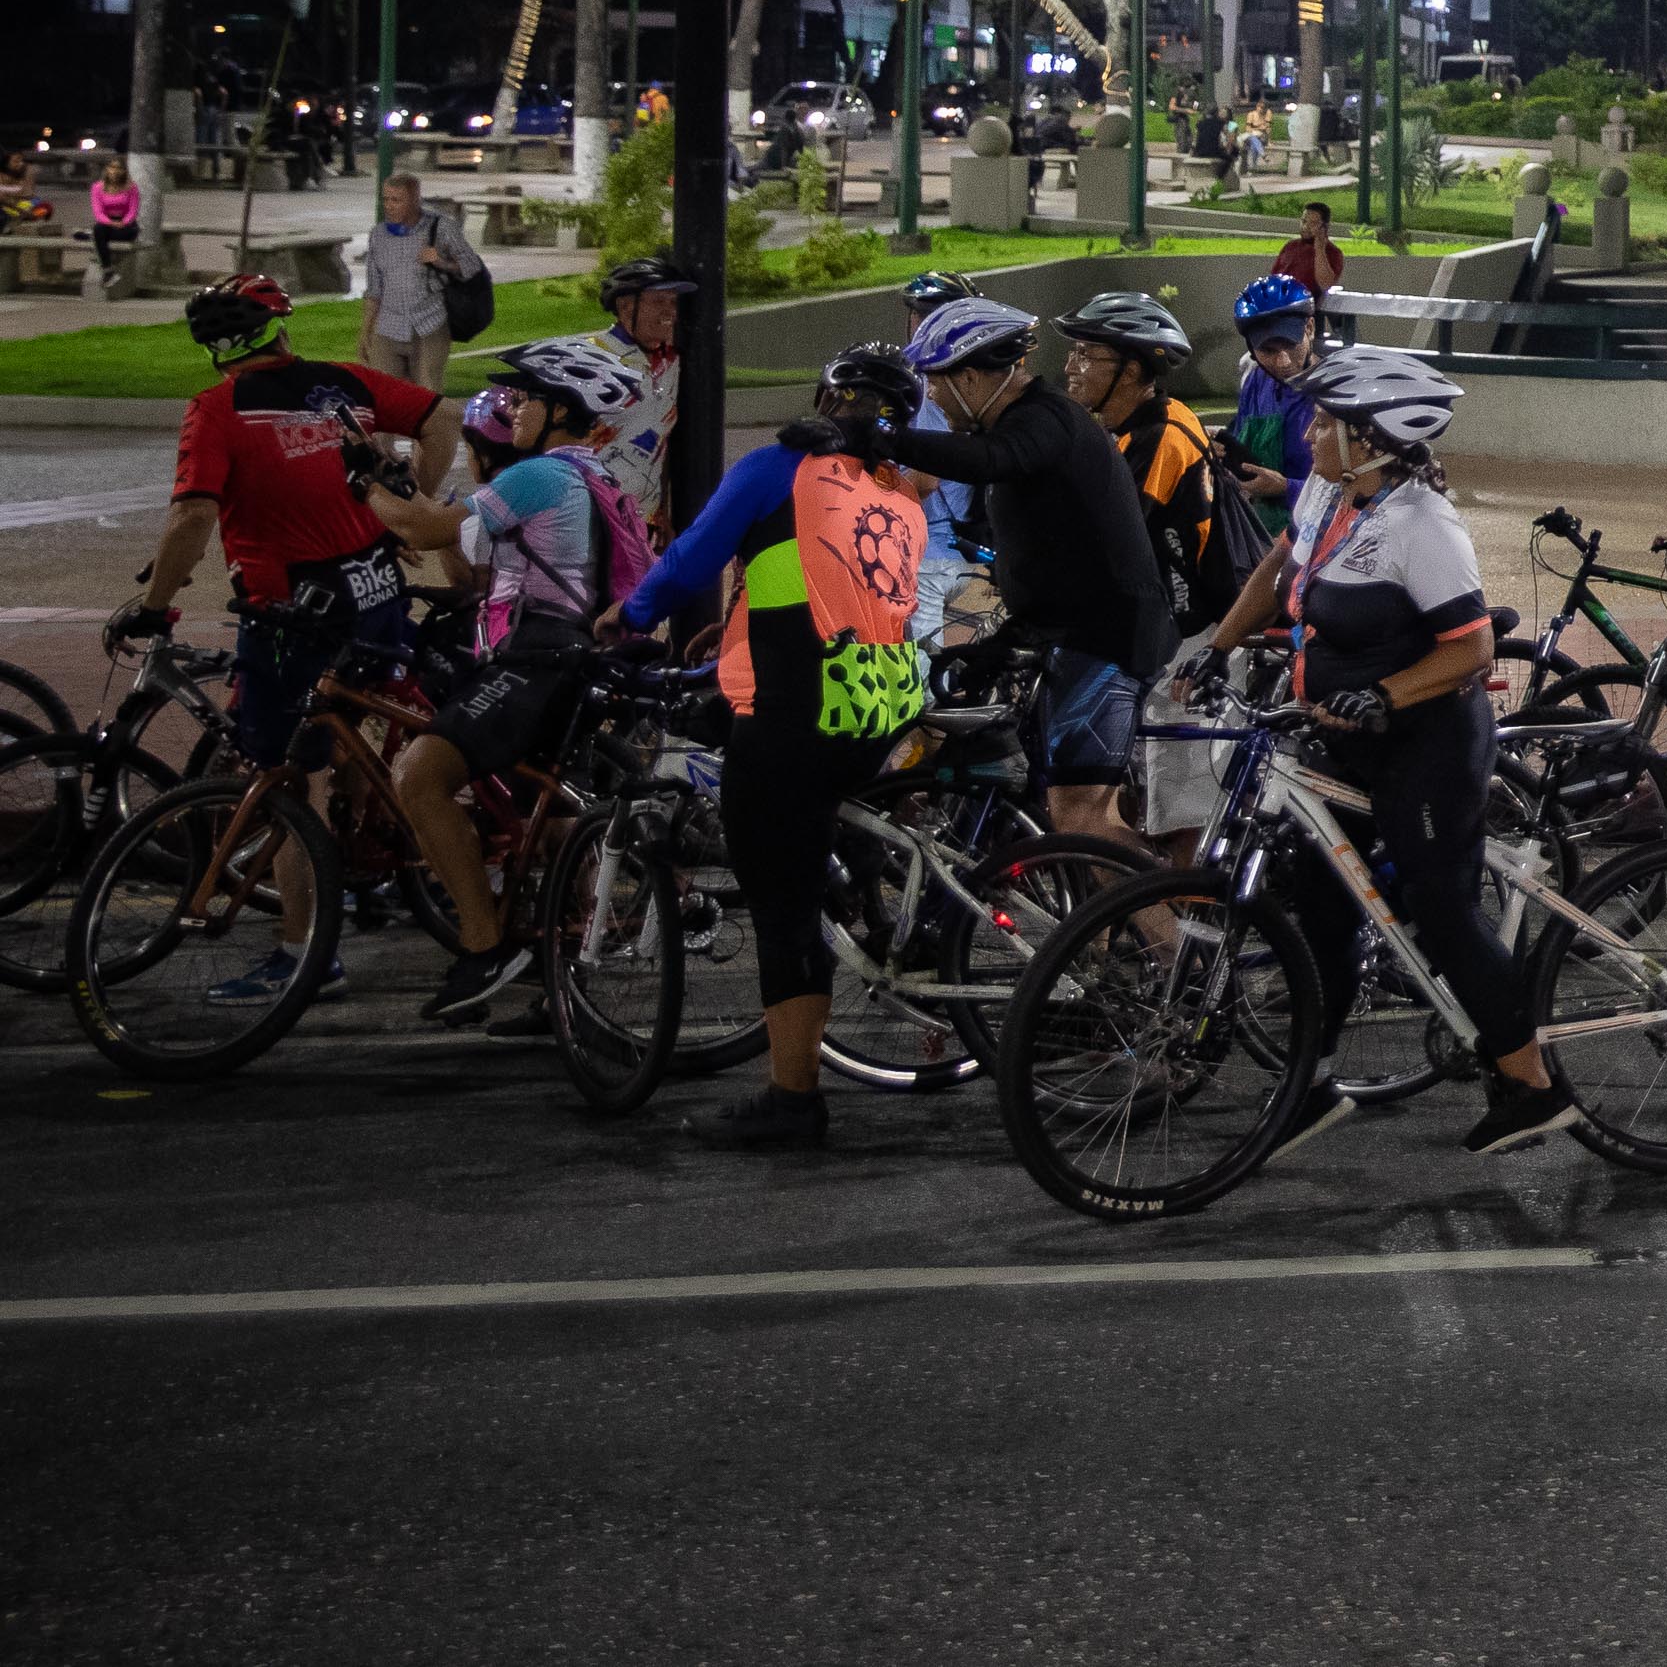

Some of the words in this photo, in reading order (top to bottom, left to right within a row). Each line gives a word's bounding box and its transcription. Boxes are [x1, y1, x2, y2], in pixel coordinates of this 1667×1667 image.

[346, 562, 398, 599] Bike
[357, 583, 401, 613] MONAY
[459, 670, 530, 720] Lepiny
[1081, 1188, 1166, 1212] MAXXIS
